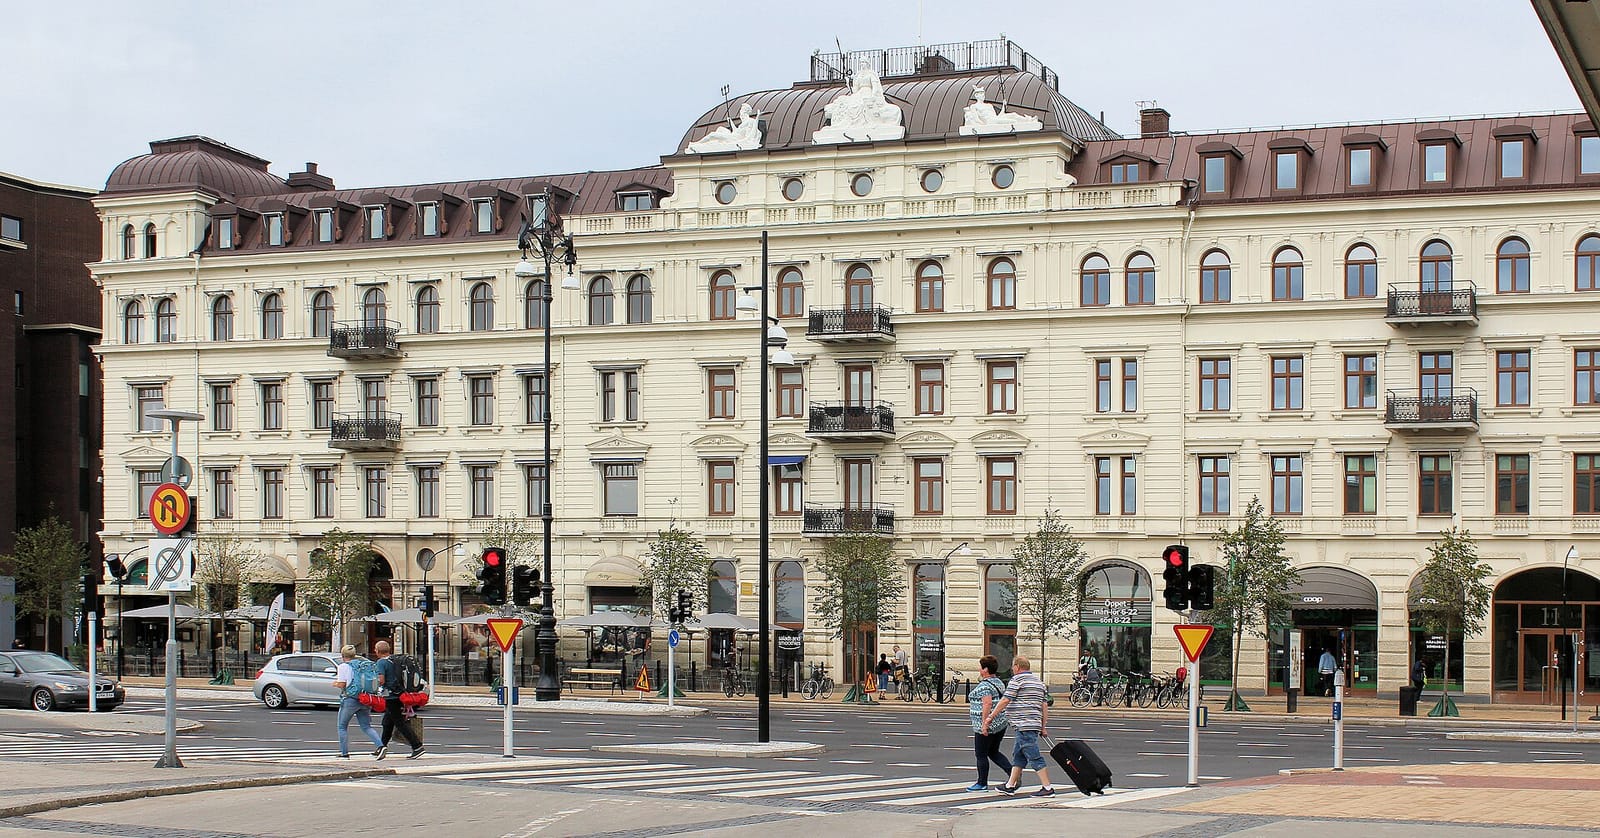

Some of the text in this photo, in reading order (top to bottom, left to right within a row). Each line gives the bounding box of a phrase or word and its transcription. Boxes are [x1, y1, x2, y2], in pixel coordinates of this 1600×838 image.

[1104, 599, 1127, 608] Öppet
[1303, 596, 1323, 604] coop
[1121, 608, 1138, 616] 6-22
[1540, 607, 1560, 626] 11
